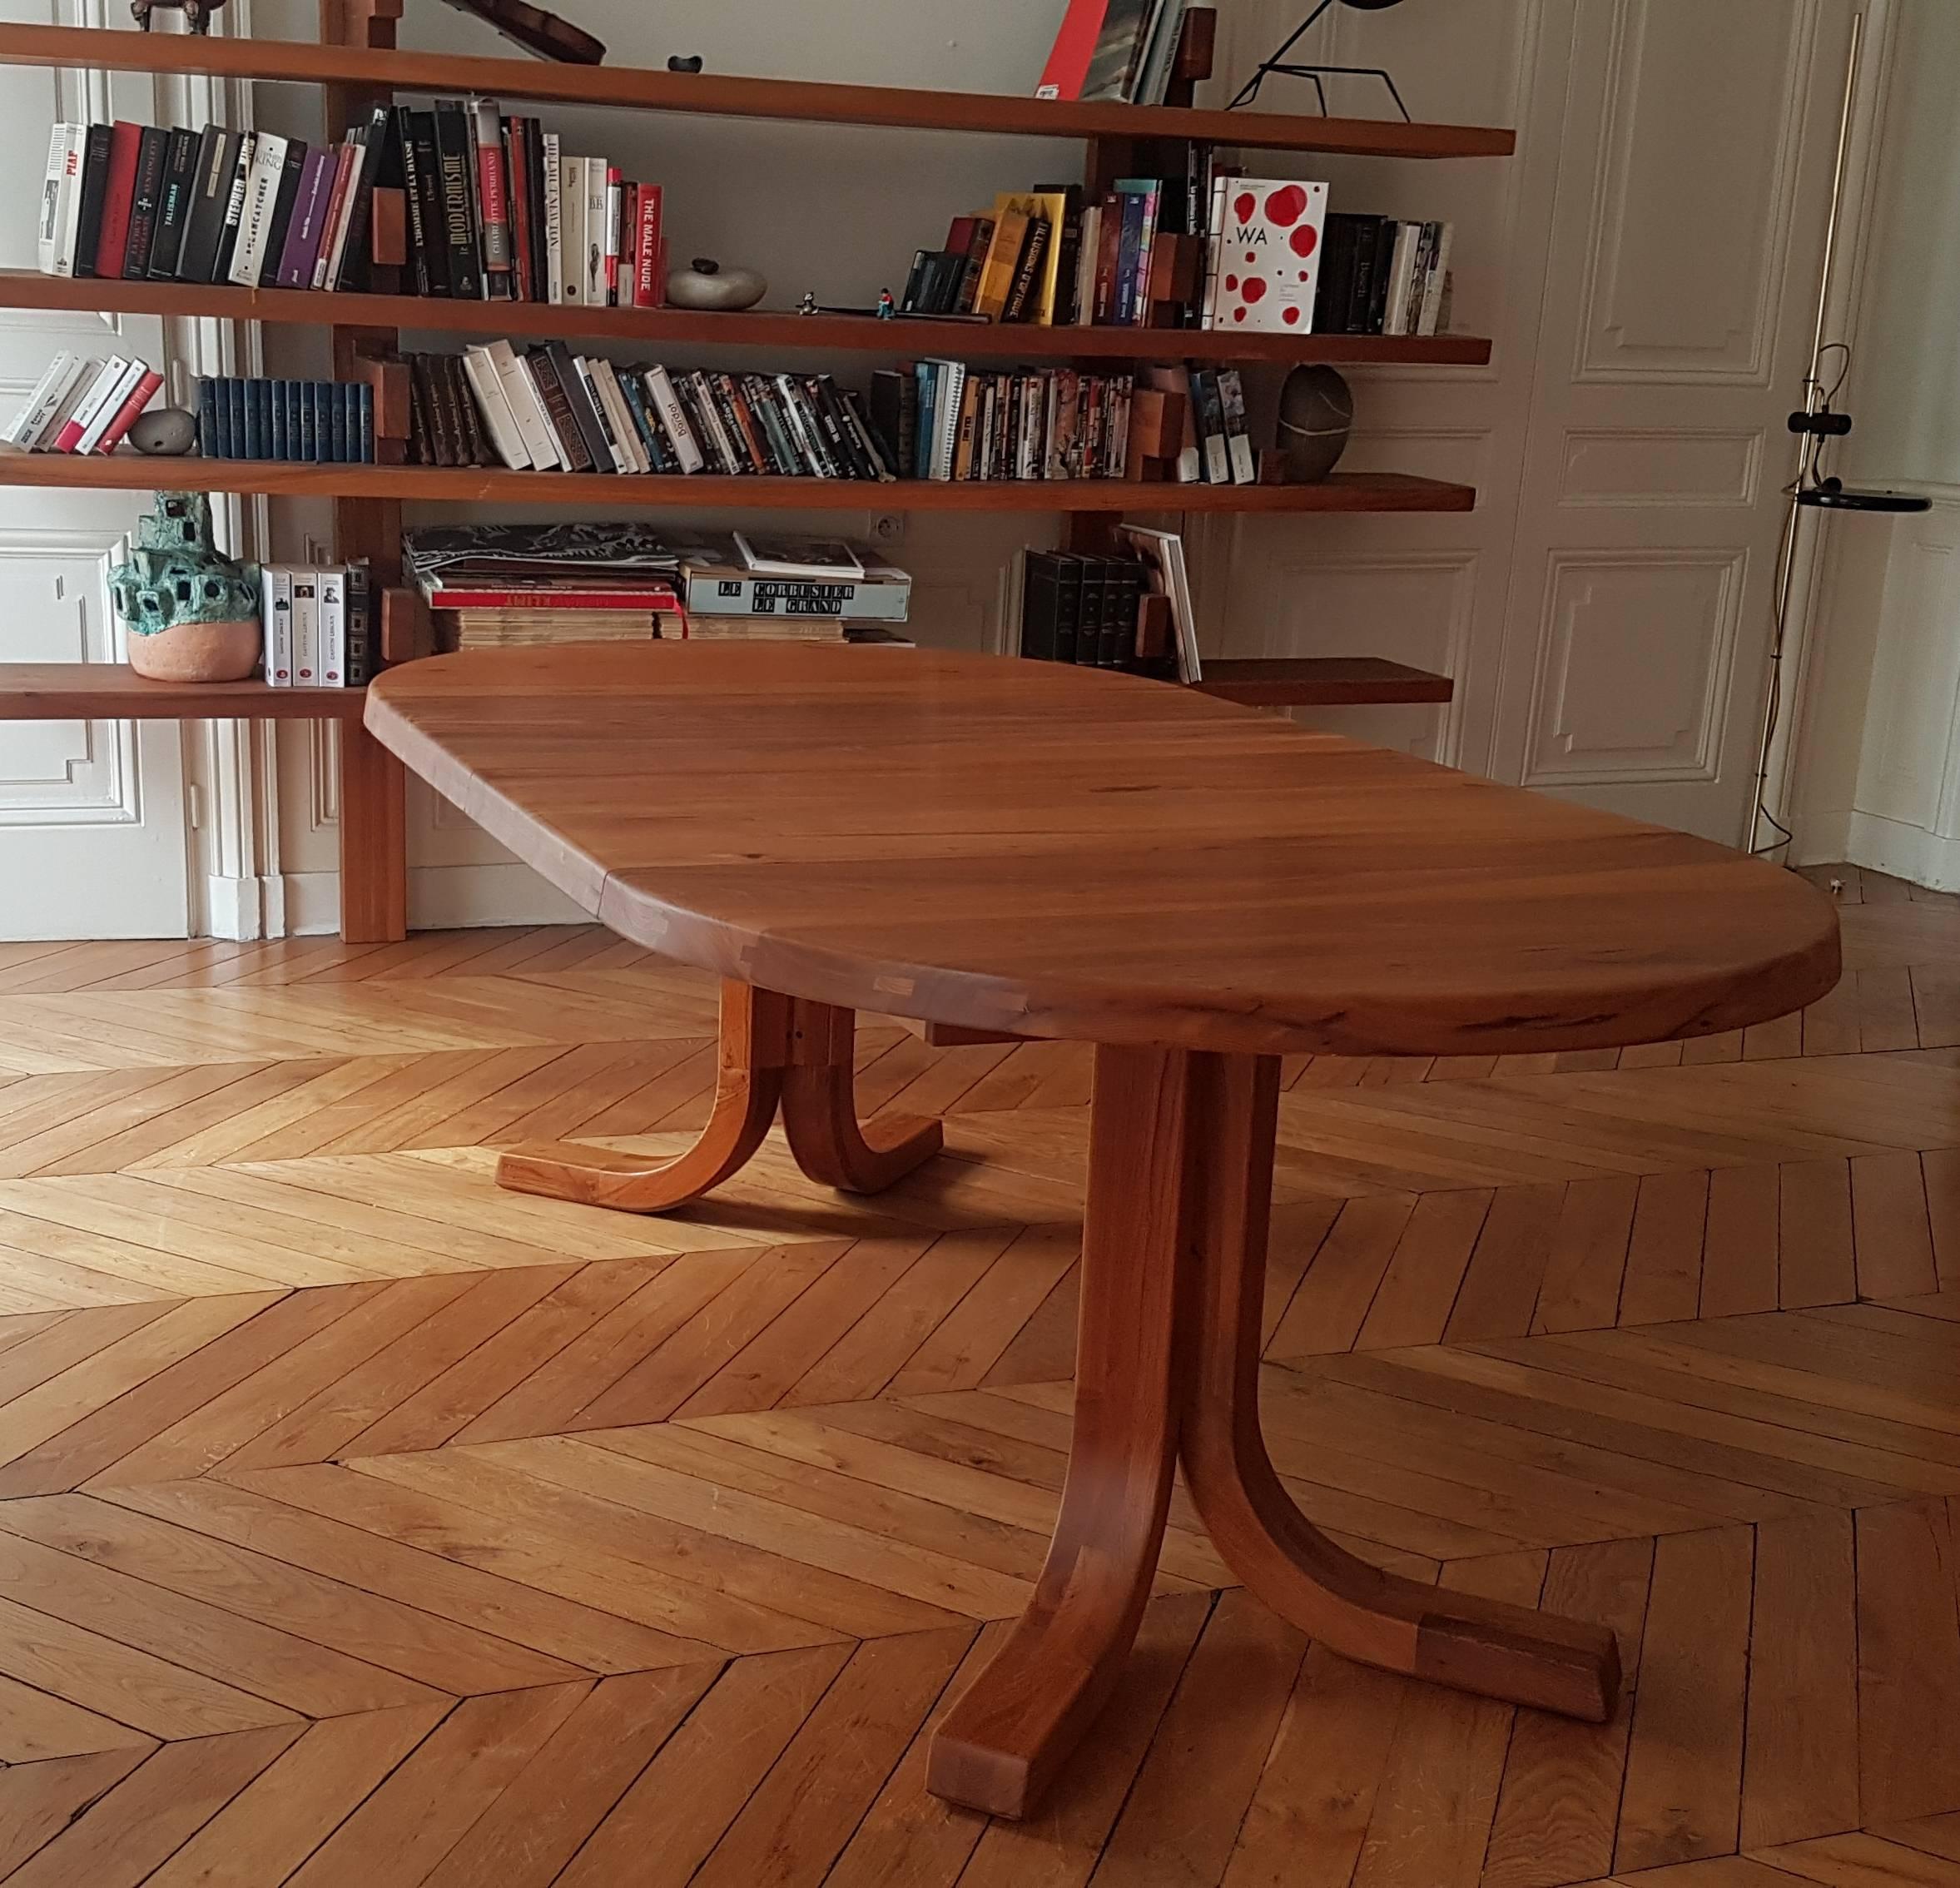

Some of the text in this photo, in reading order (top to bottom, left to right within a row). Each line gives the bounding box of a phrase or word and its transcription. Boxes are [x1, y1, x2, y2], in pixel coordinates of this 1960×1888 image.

[67, 150, 77, 176] PIAF
[408, 174, 417, 186] LA
[164, 183, 178, 226] TALISMAN
[226, 178, 246, 226] STEPHEN
[442, 152, 469, 244] MODERNISME
[487, 152, 500, 253] CHARLOTTE PERRIAND
[548, 142, 558, 246] HELMUT NEWTON
[641, 199, 654, 291] THE MALE NUDE
[1236, 227, 1268, 245] WA
[718, 581, 855, 599] LE CORBUSIER
[752, 599, 842, 614] LE GRAND
